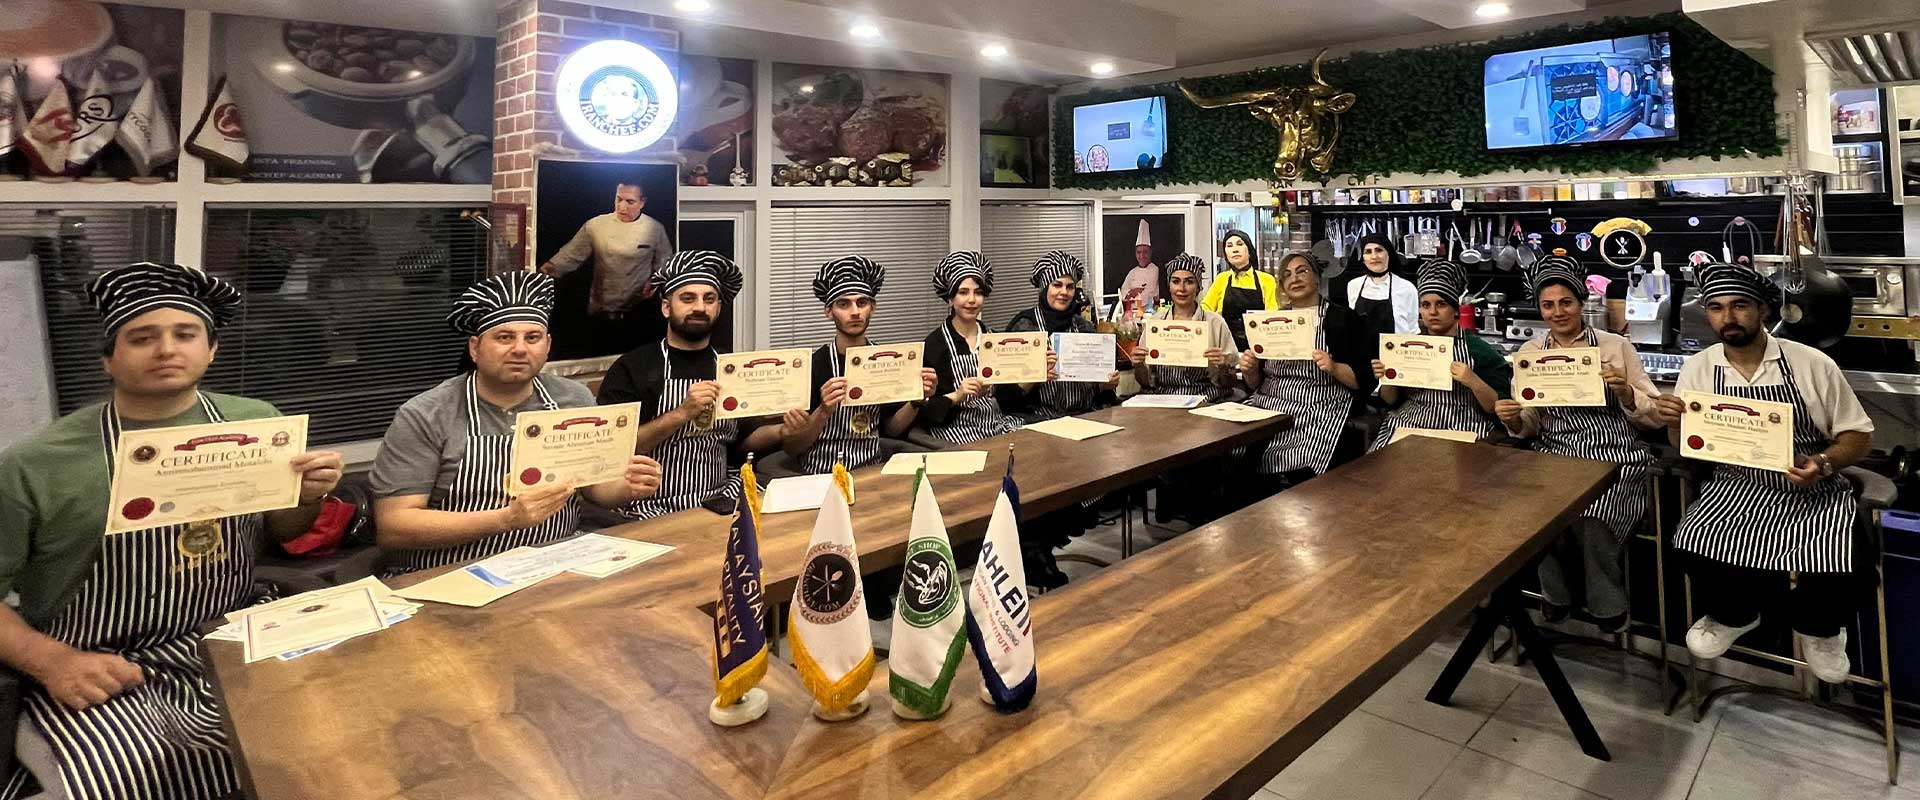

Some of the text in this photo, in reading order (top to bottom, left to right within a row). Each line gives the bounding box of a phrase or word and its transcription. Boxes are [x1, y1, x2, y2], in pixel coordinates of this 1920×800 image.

[1704, 412, 1767, 428] CERTIFICATE
[543, 428, 613, 444] CERTIFICATE
[161, 447, 268, 468] CERTIFICATE
